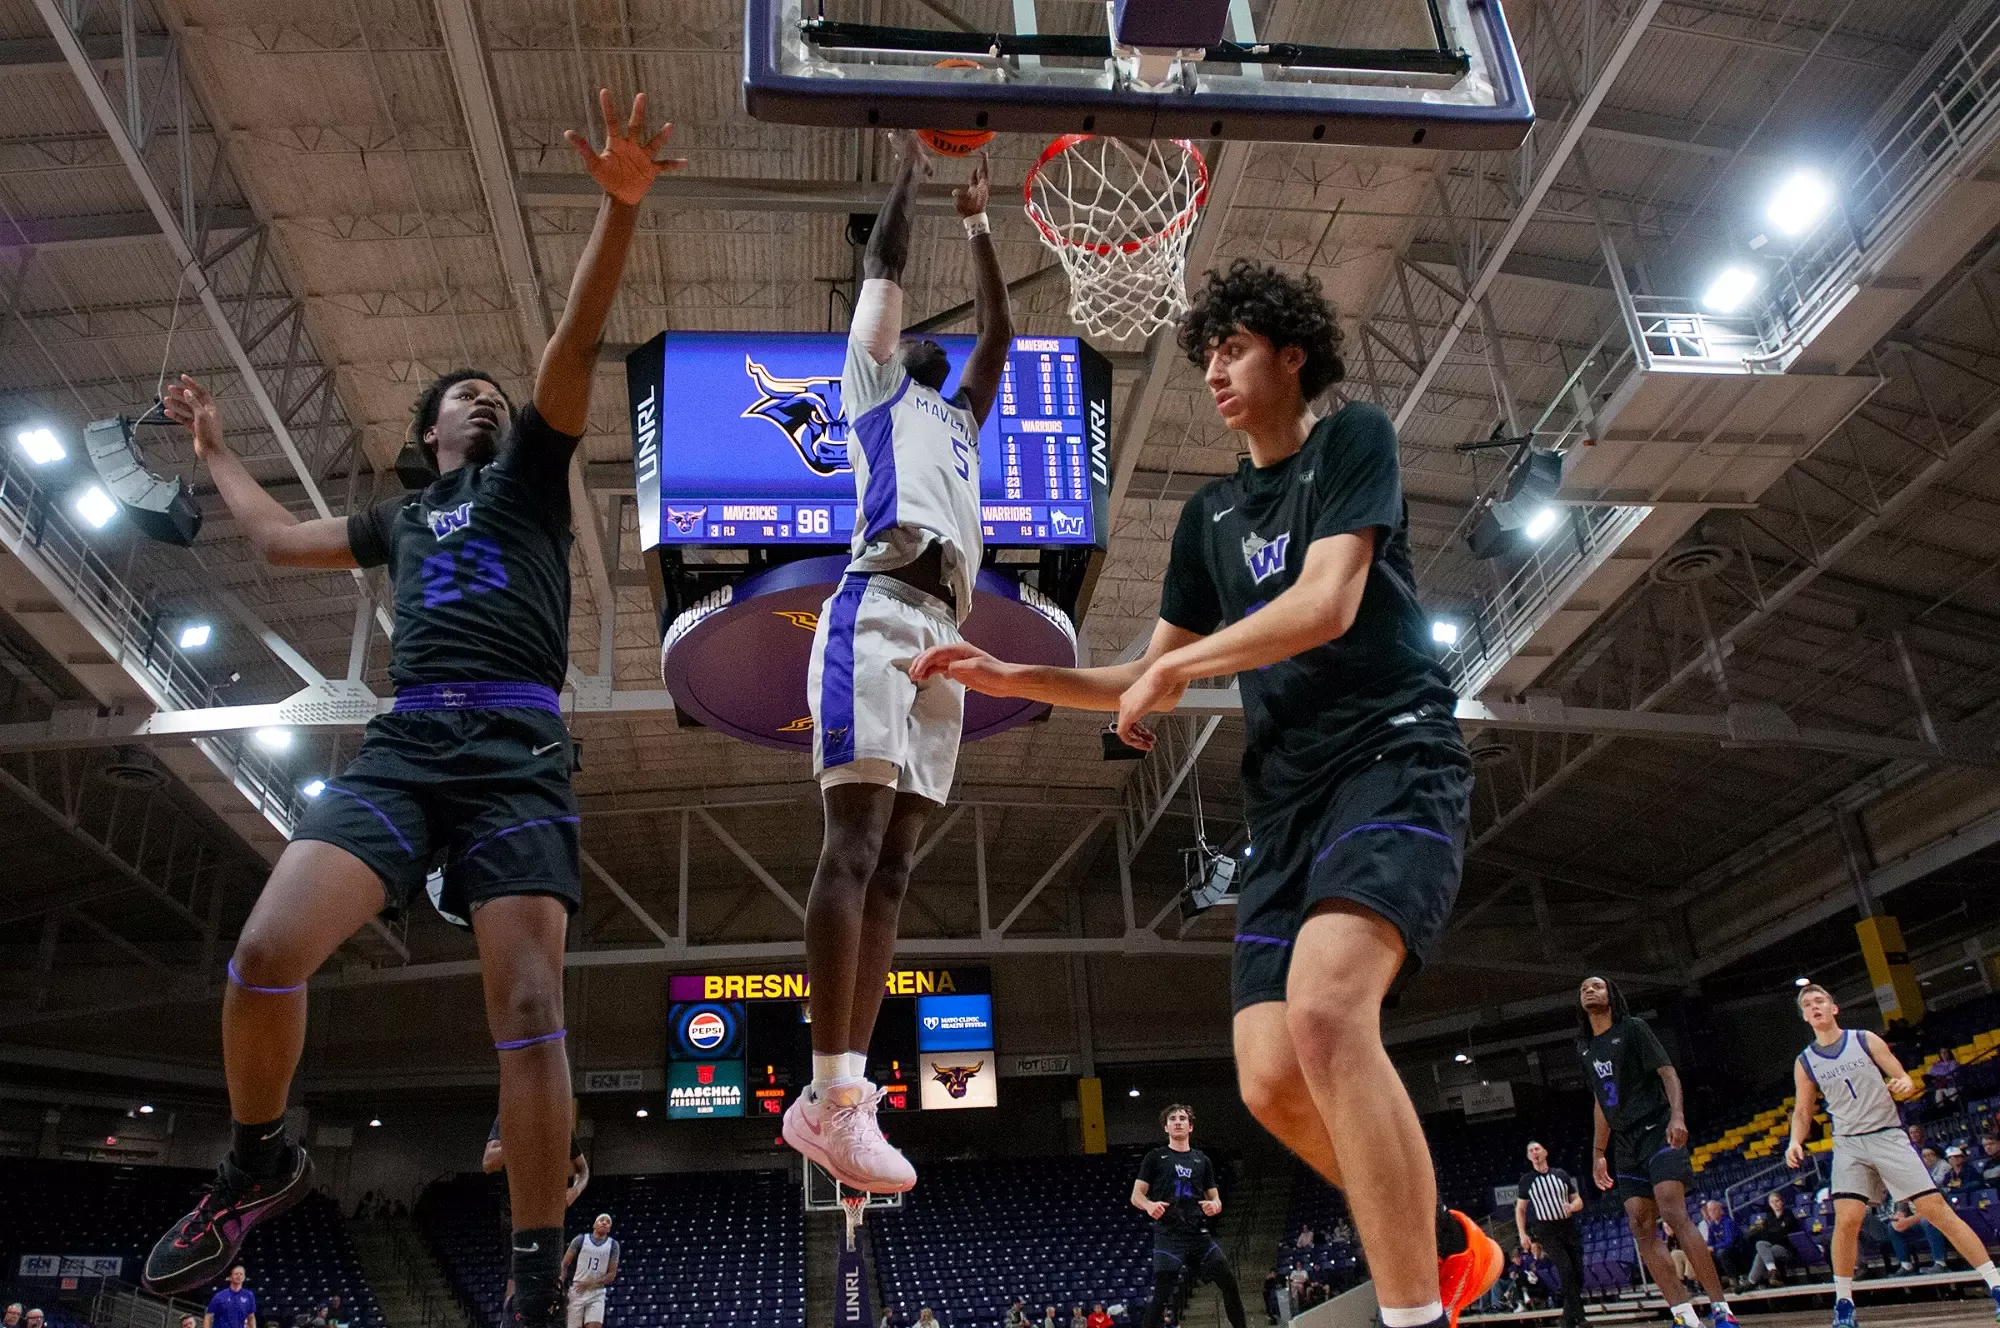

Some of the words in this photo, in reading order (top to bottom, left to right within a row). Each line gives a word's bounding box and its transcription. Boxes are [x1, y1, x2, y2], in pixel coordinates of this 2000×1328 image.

[1016, 339, 1060, 352] MAVERICKS
[1066, 363, 1072, 372] 1
[1004, 373, 1010, 382] 1
[1066, 373, 1074, 383] 0
[1068, 384, 1072, 394] 1
[1068, 395, 1074, 404] 1
[1021, 420, 1063, 432] WARRIORS
[638, 384, 657, 484] UNRL
[1090, 398, 1107, 486] UNRL
[1008, 444, 1016, 454] 3
[1048, 444, 1055, 454] 0
[1072, 445, 1078, 454] 1
[950, 435, 969, 482] 5
[1048, 456, 1056, 466] 2
[1072, 456, 1080, 466] 0
[1008, 466, 1018, 476] 14
[1073, 467, 1080, 476] 2
[1006, 477, 1020, 488] 23
[1050, 478, 1058, 488] 0
[1074, 478, 1081, 488] 2
[1008, 489, 1021, 500] 24
[1074, 489, 1082, 500] 2
[722, 506, 778, 521] MAVERICKS
[797, 509, 829, 534] 96
[982, 506, 1032, 522] WARRIORS
[710, 526, 719, 537] 3
[724, 525, 736, 537] FLS
[762, 525, 776, 537] TOL
[780, 526, 789, 537] 3
[983, 526, 995, 536] TOL
[1020, 526, 1032, 536] FLS
[421, 540, 510, 609] 23
[692, 1026, 722, 1035] PEPSI
[1820, 1058, 1866, 1080] MAVERICKS
[670, 1086, 740, 1098] MASCHKA
[1845, 1078, 1858, 1100] 1
[670, 1098, 710, 1107] PERSONAL
[712, 1097, 740, 1106] INJURY
[764, 1099, 780, 1114] 96
[890, 1096, 906, 1108] 48
[588, 1257, 600, 1270] 13
[846, 1266, 860, 1320] UNRL
